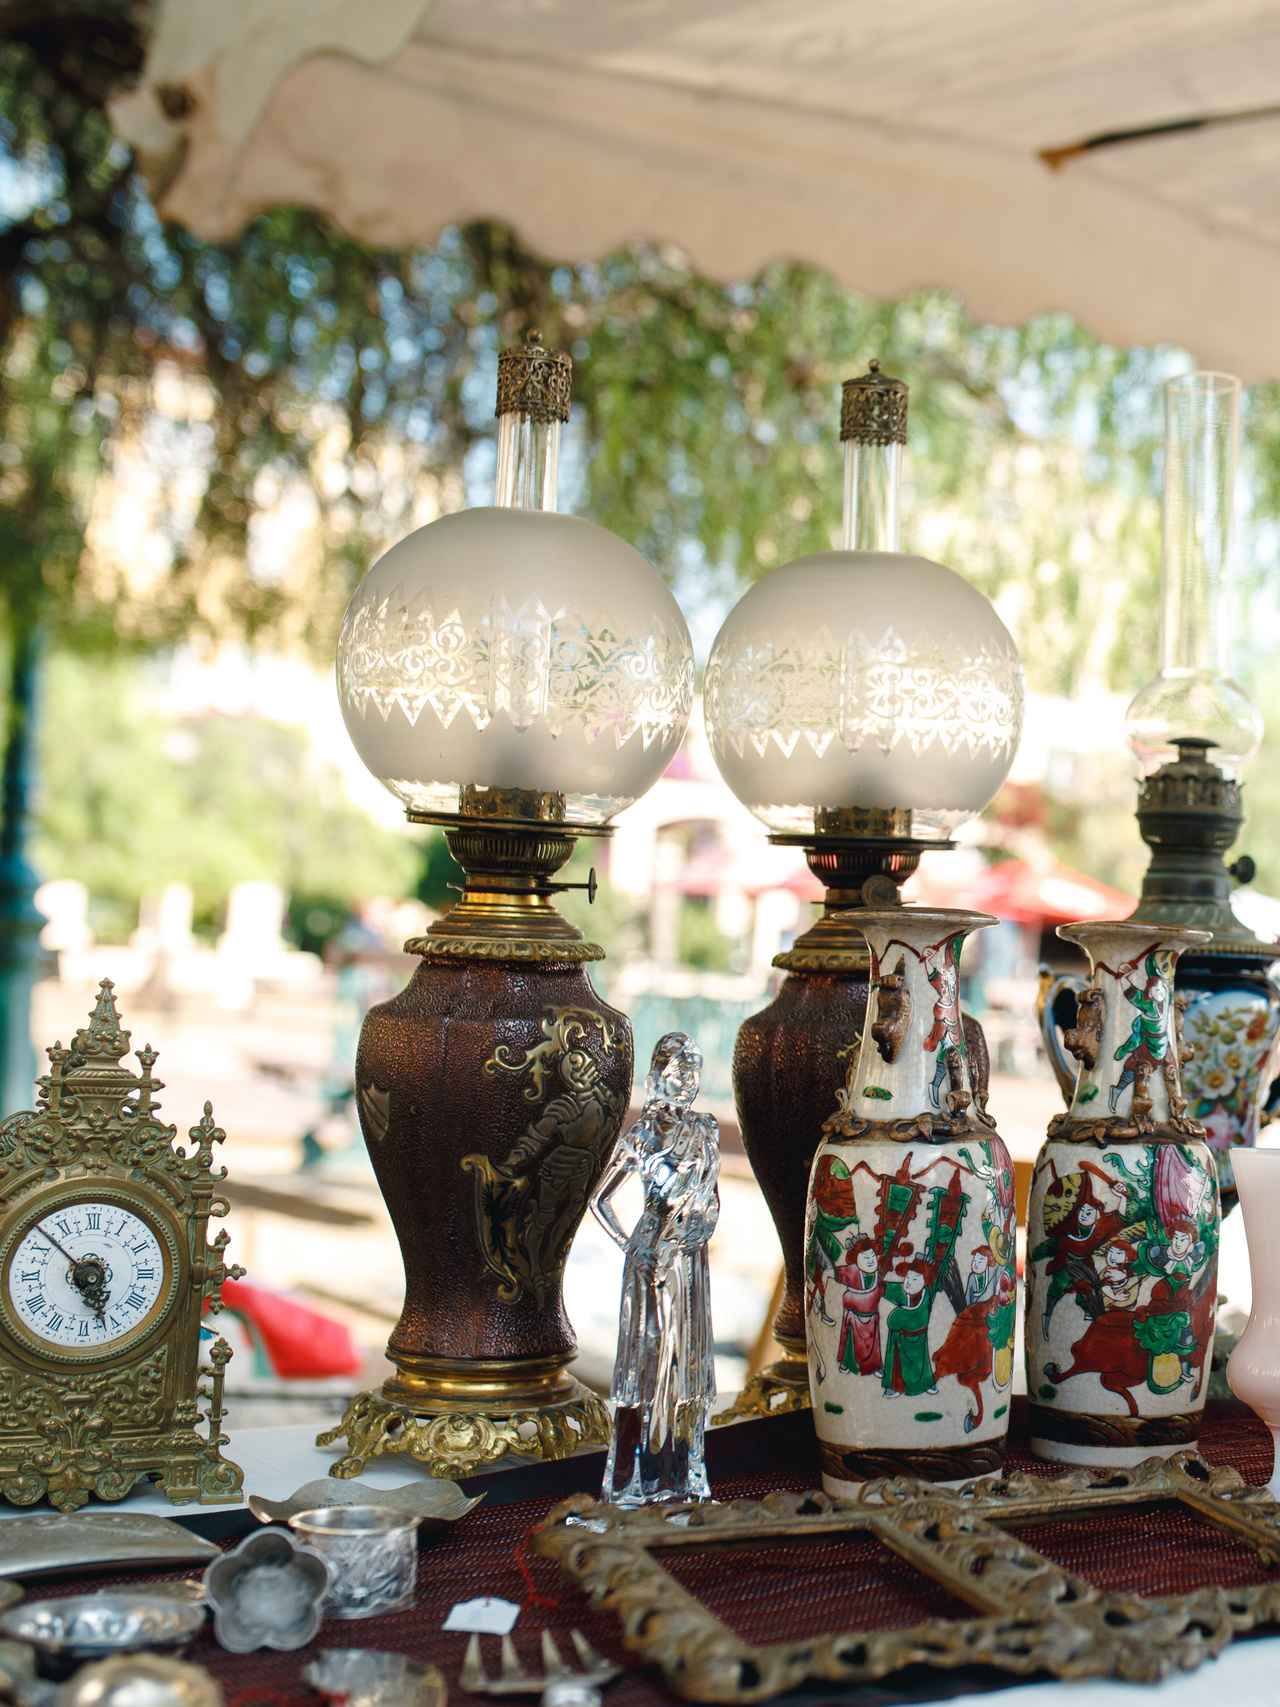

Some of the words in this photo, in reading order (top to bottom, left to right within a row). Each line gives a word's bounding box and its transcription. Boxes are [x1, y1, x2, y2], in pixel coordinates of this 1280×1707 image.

[55, 1219, 73, 1239] XI
[85, 1213, 101, 1230] XII
[30, 1241, 51, 1257] X
[131, 1240, 150, 1256] II
[21, 1269, 40, 1282] IX
[137, 1267, 154, 1280] III
[25, 1292, 47, 1315] VIII
[124, 1291, 147, 1311] IIII
[46, 1313, 64, 1332] VII
[77, 1320, 89, 1336] VI
[109, 1315, 122, 1330] V
